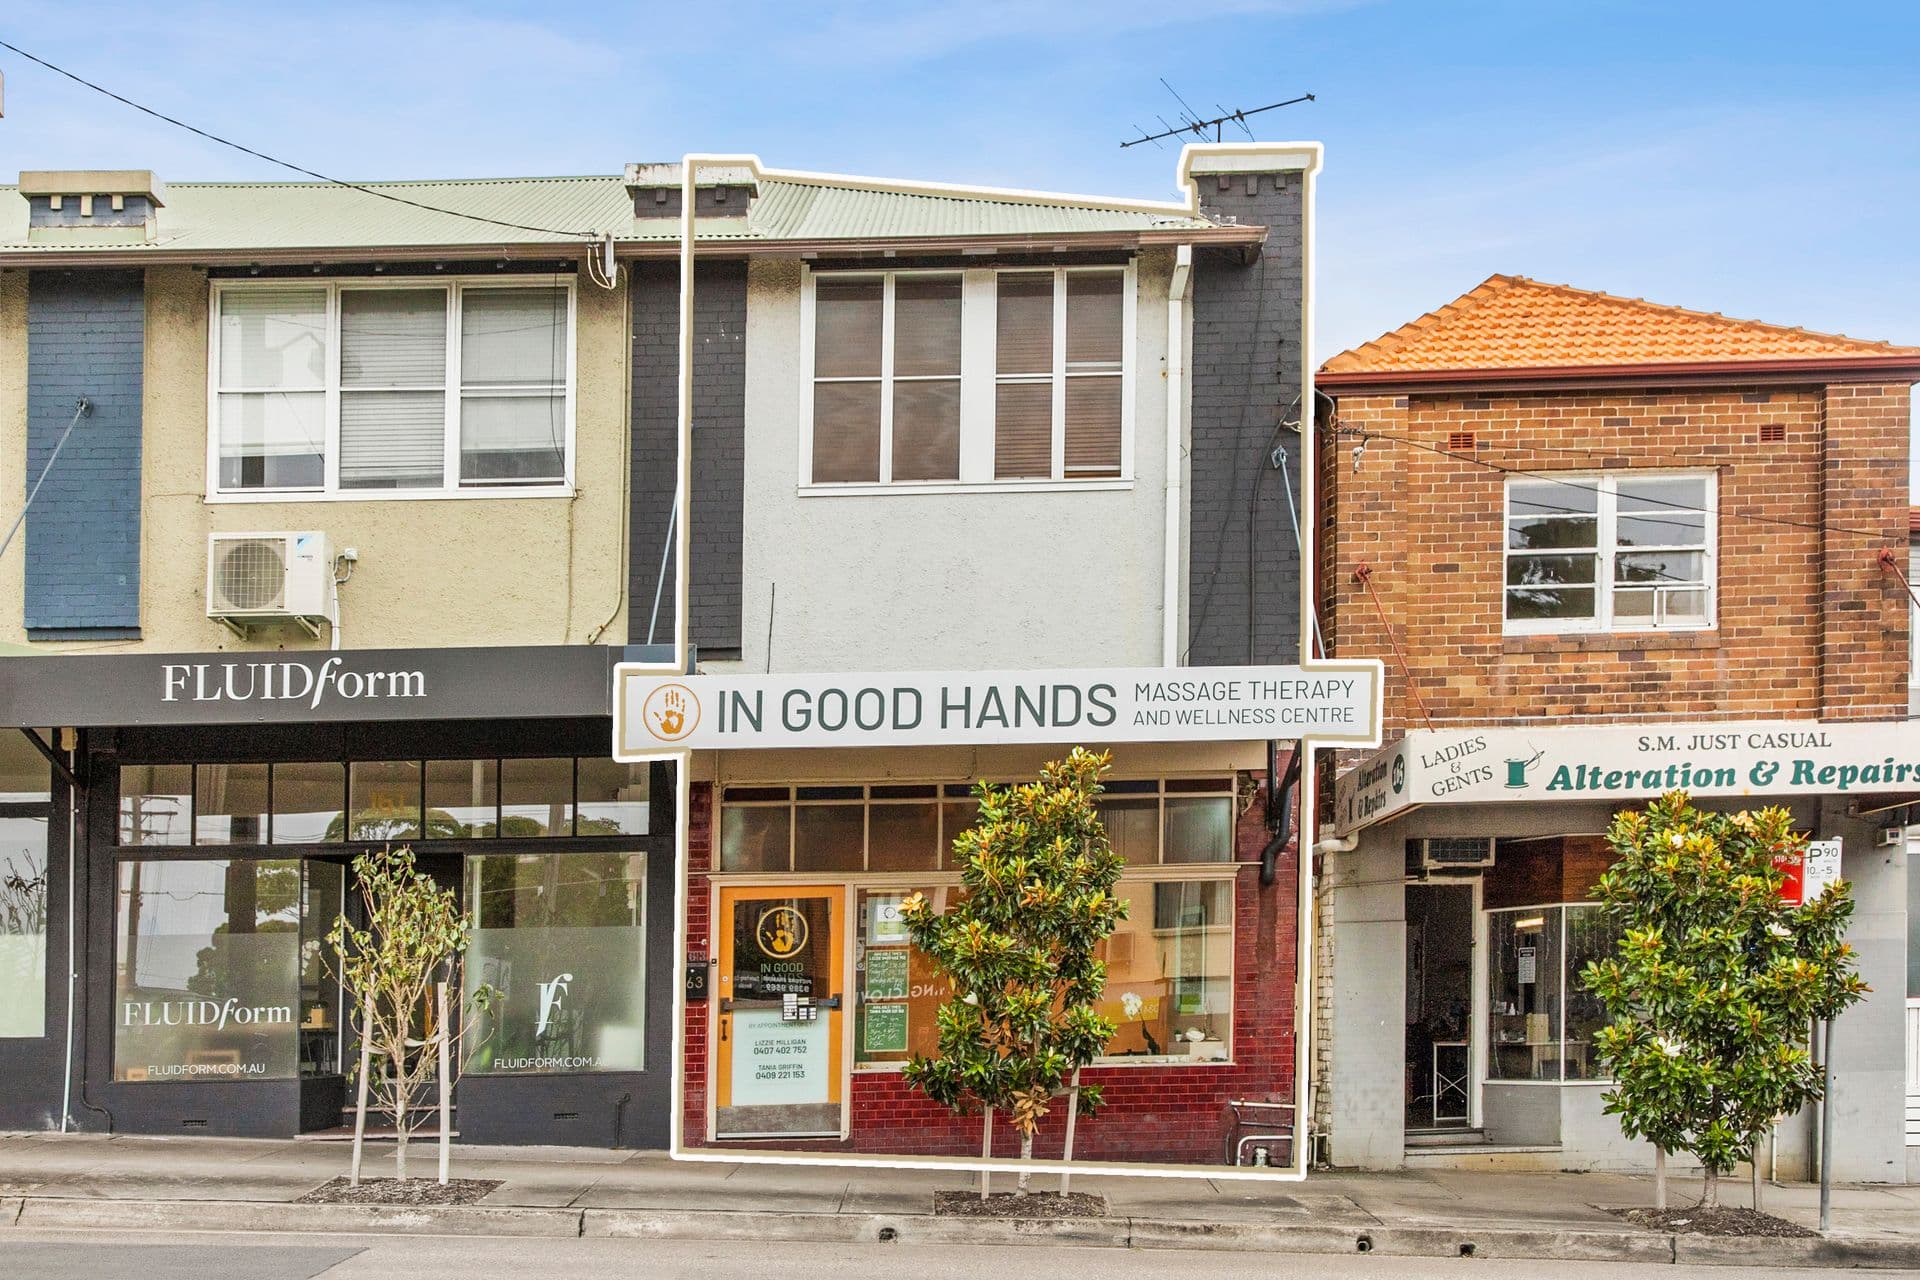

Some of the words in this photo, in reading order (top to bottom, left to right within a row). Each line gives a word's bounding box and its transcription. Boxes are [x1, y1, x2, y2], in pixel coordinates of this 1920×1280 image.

[161, 657, 427, 710] FLUIDform
[1134, 680, 1241, 702] MASSAGE
[1248, 679, 1355, 700] THERAPY
[718, 690, 763, 733] IN
[782, 687, 922, 732] GOOD
[940, 683, 1118, 729] HANDS
[1133, 709, 1171, 726] AND
[1175, 707, 1276, 725] WELLNESS
[1280, 706, 1355, 723] CENTRE
[1637, 735, 1681, 752] S.M.
[1687, 734, 1742, 751] JUST
[1747, 732, 1833, 749] CASUAL
[1420, 736, 1487, 769] LADIES
[1450, 761, 1461, 774] &
[1545, 762, 1737, 791] Alteration
[1749, 760, 1781, 787] &
[1431, 765, 1493, 796] GENTS
[1809, 848, 1822, 863] P
[1824, 847, 1838, 857] 90
[760, 963, 771, 973] IN
[773, 962, 804, 973] GOOD
[123, 997, 291, 1031] FLUIDform
[754, 1047, 774, 1055] 0407
[776, 1046, 791, 1054] 402
[793, 1046, 807, 1054] 752
[148, 1063, 265, 1075] FLUIDFORM.COM.AU
[756, 1072, 776, 1080] 0409
[778, 1071, 791, 1079] 221
[792, 1071, 805, 1079] 153
